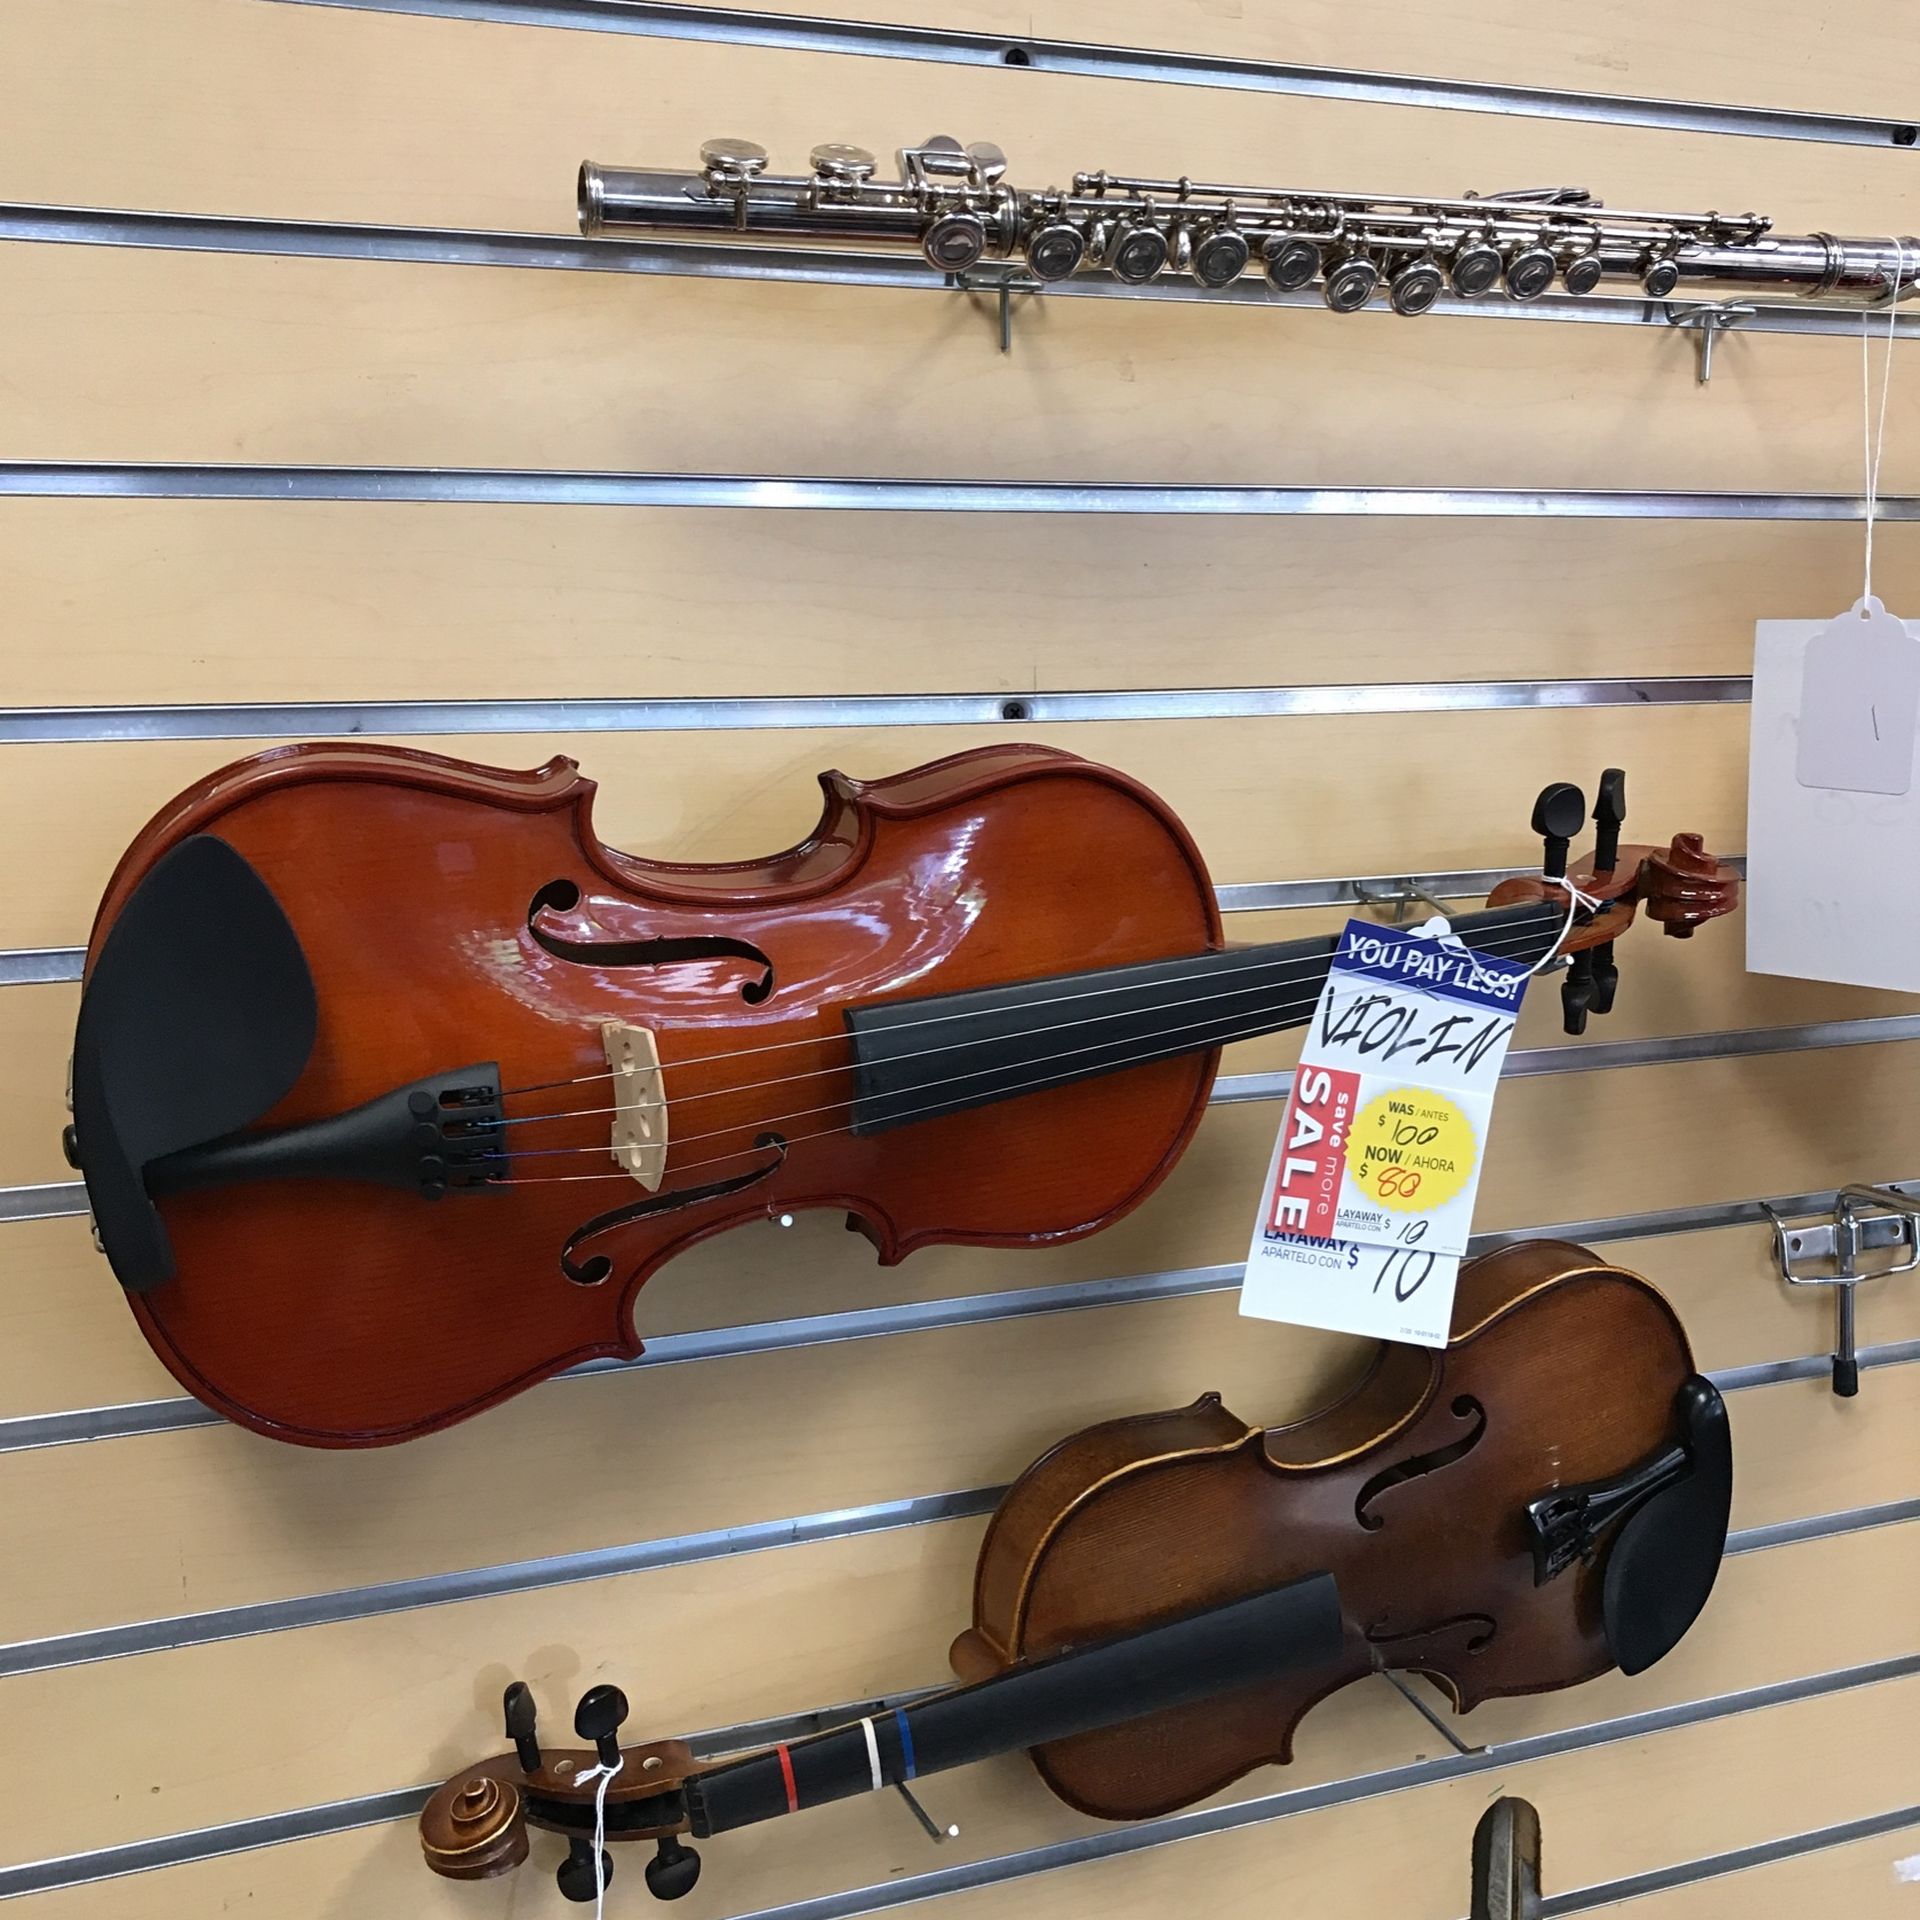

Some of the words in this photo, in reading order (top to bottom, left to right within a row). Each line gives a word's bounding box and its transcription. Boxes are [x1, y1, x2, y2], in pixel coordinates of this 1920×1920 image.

[1348, 933, 1401, 968] YOU
[1402, 949, 1454, 982] PAY
[1453, 960, 1519, 1001] LESS!
[1321, 986, 1514, 1074] VIOLIN
[1329, 1092, 1349, 1148] save
[1378, 1114, 1386, 1127] $
[1391, 1119, 1439, 1146] 100
[1389, 1101, 1415, 1116] WAS
[1420, 1109, 1449, 1121] ANTES
[1274, 1068, 1332, 1230] SALE
[1365, 1145, 1403, 1164] NOW
[1413, 1155, 1454, 1173] AHORA
[1317, 1156, 1338, 1216] more
[1359, 1162, 1369, 1179] $
[1377, 1167, 1421, 1198] 80
[1337, 1207, 1383, 1222] LAYAWAY
[1384, 1218, 1391, 1230] $
[1397, 1220, 1429, 1245] 10
[1264, 1224, 1348, 1252] LAYAWAY
[1347, 1243, 1359, 1270] $
[1373, 1248, 1436, 1304] 10
[1318, 1255, 1342, 1269] CON
